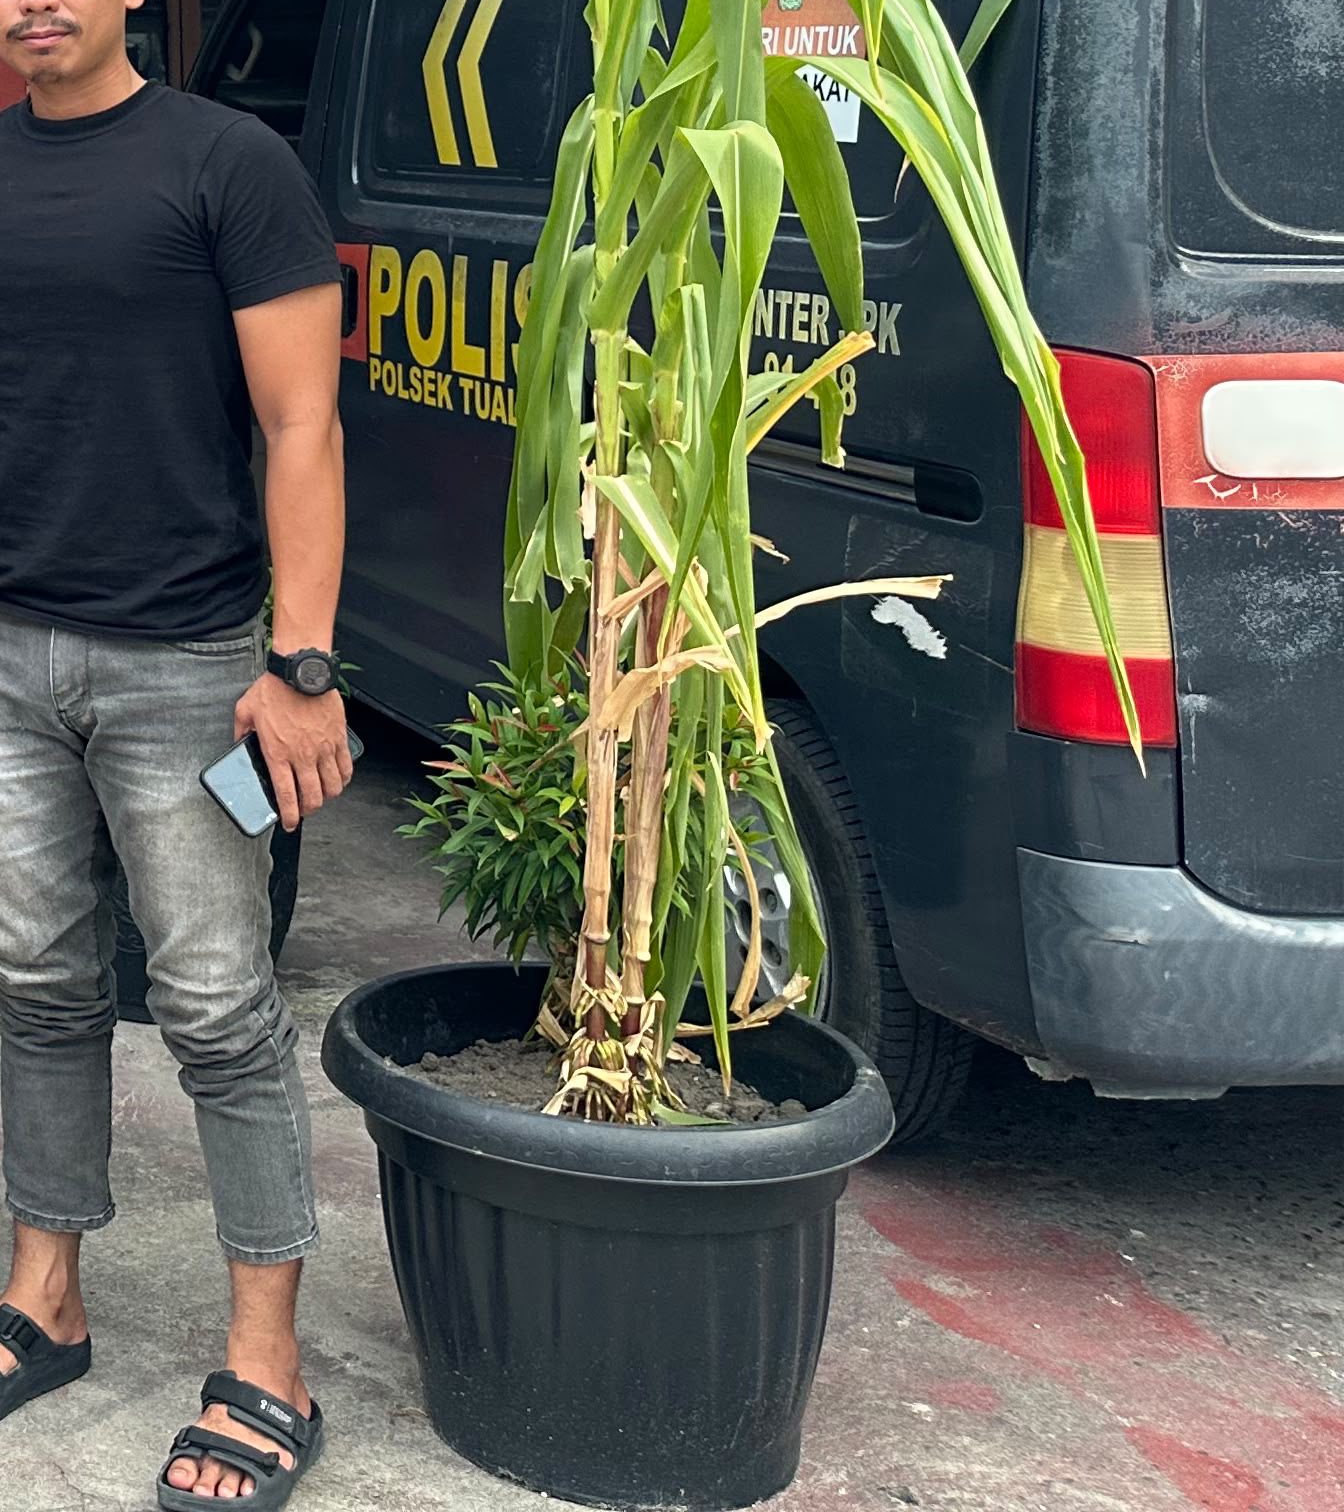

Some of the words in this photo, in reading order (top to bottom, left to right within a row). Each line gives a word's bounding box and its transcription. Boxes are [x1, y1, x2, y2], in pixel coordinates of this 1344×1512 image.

[784, 25, 861, 55] UNTUK
[369, 244, 534, 383] POLI
[750, 288, 830, 346] NTER
[369, 357, 454, 411] POLSEK
[459, 377, 518, 427] TUAL
